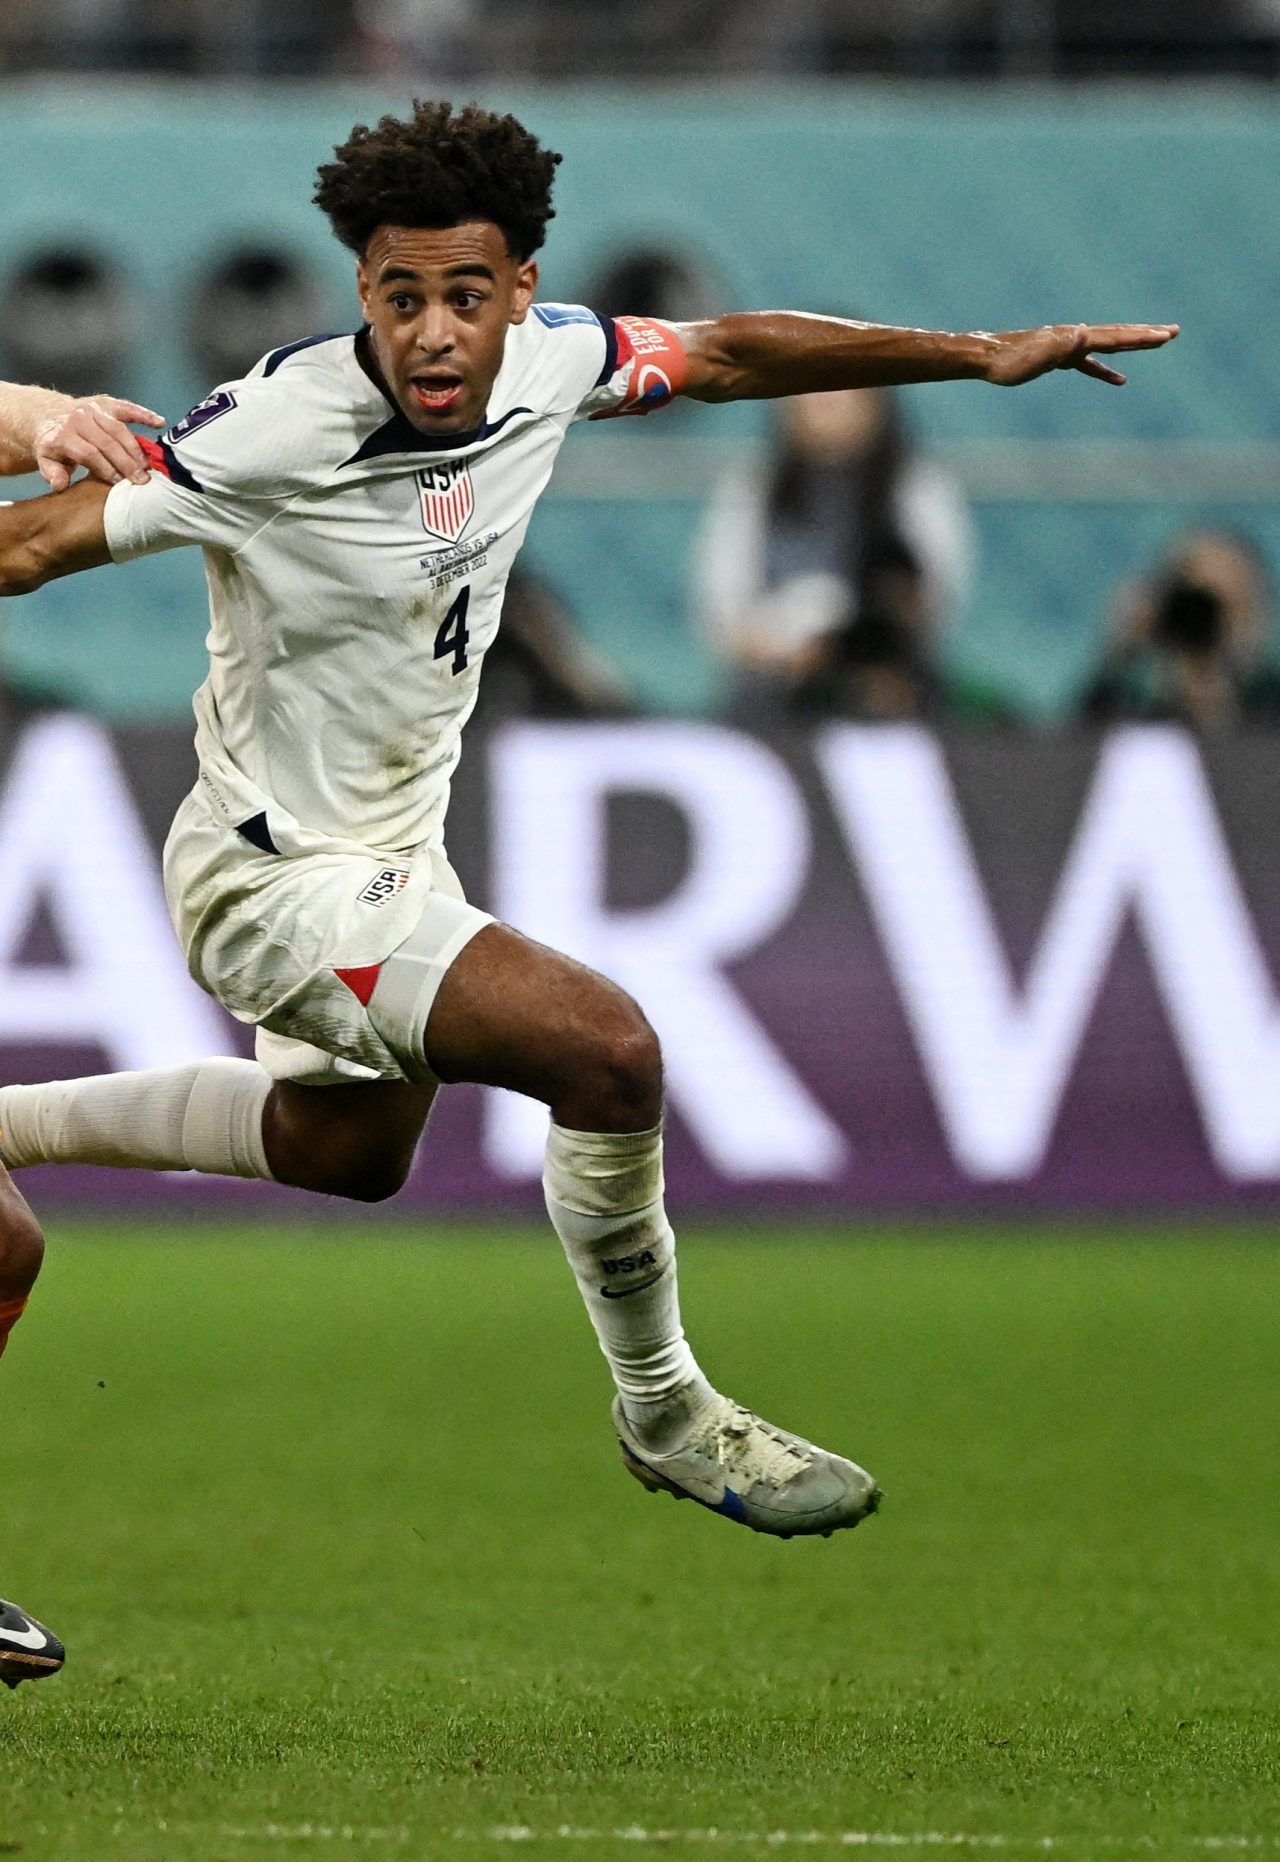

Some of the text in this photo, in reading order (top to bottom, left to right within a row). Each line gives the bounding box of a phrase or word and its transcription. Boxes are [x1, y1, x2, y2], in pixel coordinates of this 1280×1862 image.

[642, 328, 670, 352] FOR
[436, 562, 471, 588] DECEMBER
[471, 554, 488, 572] 2022
[433, 584, 470, 677] 4
[362, 871, 397, 902] USA
[602, 1250, 657, 1274] USA
